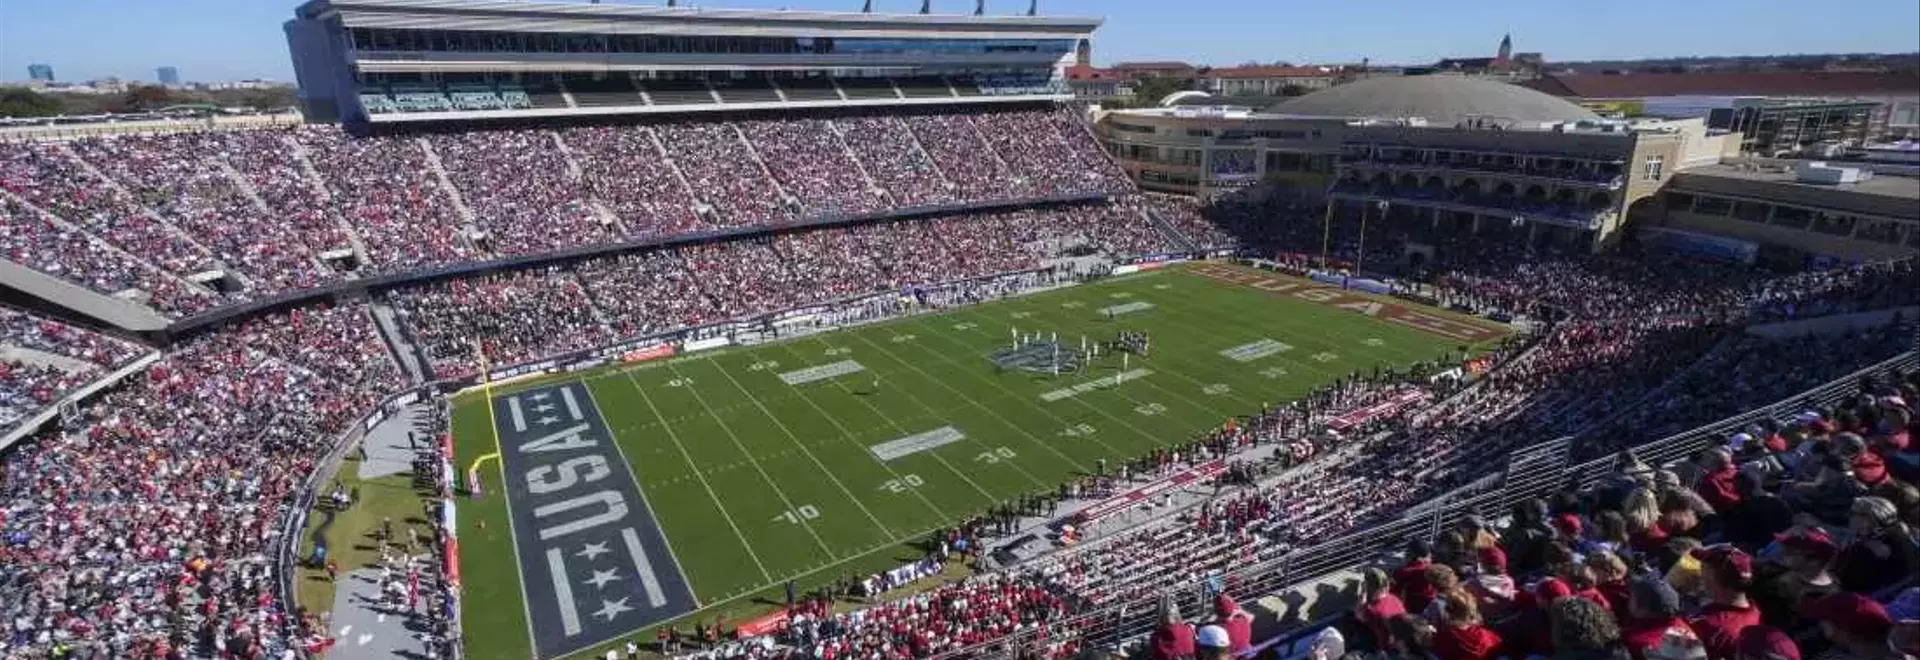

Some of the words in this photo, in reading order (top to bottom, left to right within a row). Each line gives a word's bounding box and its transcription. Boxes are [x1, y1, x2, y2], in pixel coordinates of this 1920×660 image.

[519, 421, 629, 541] USA
[888, 474, 924, 492] 20
[786, 504, 821, 523] 10
